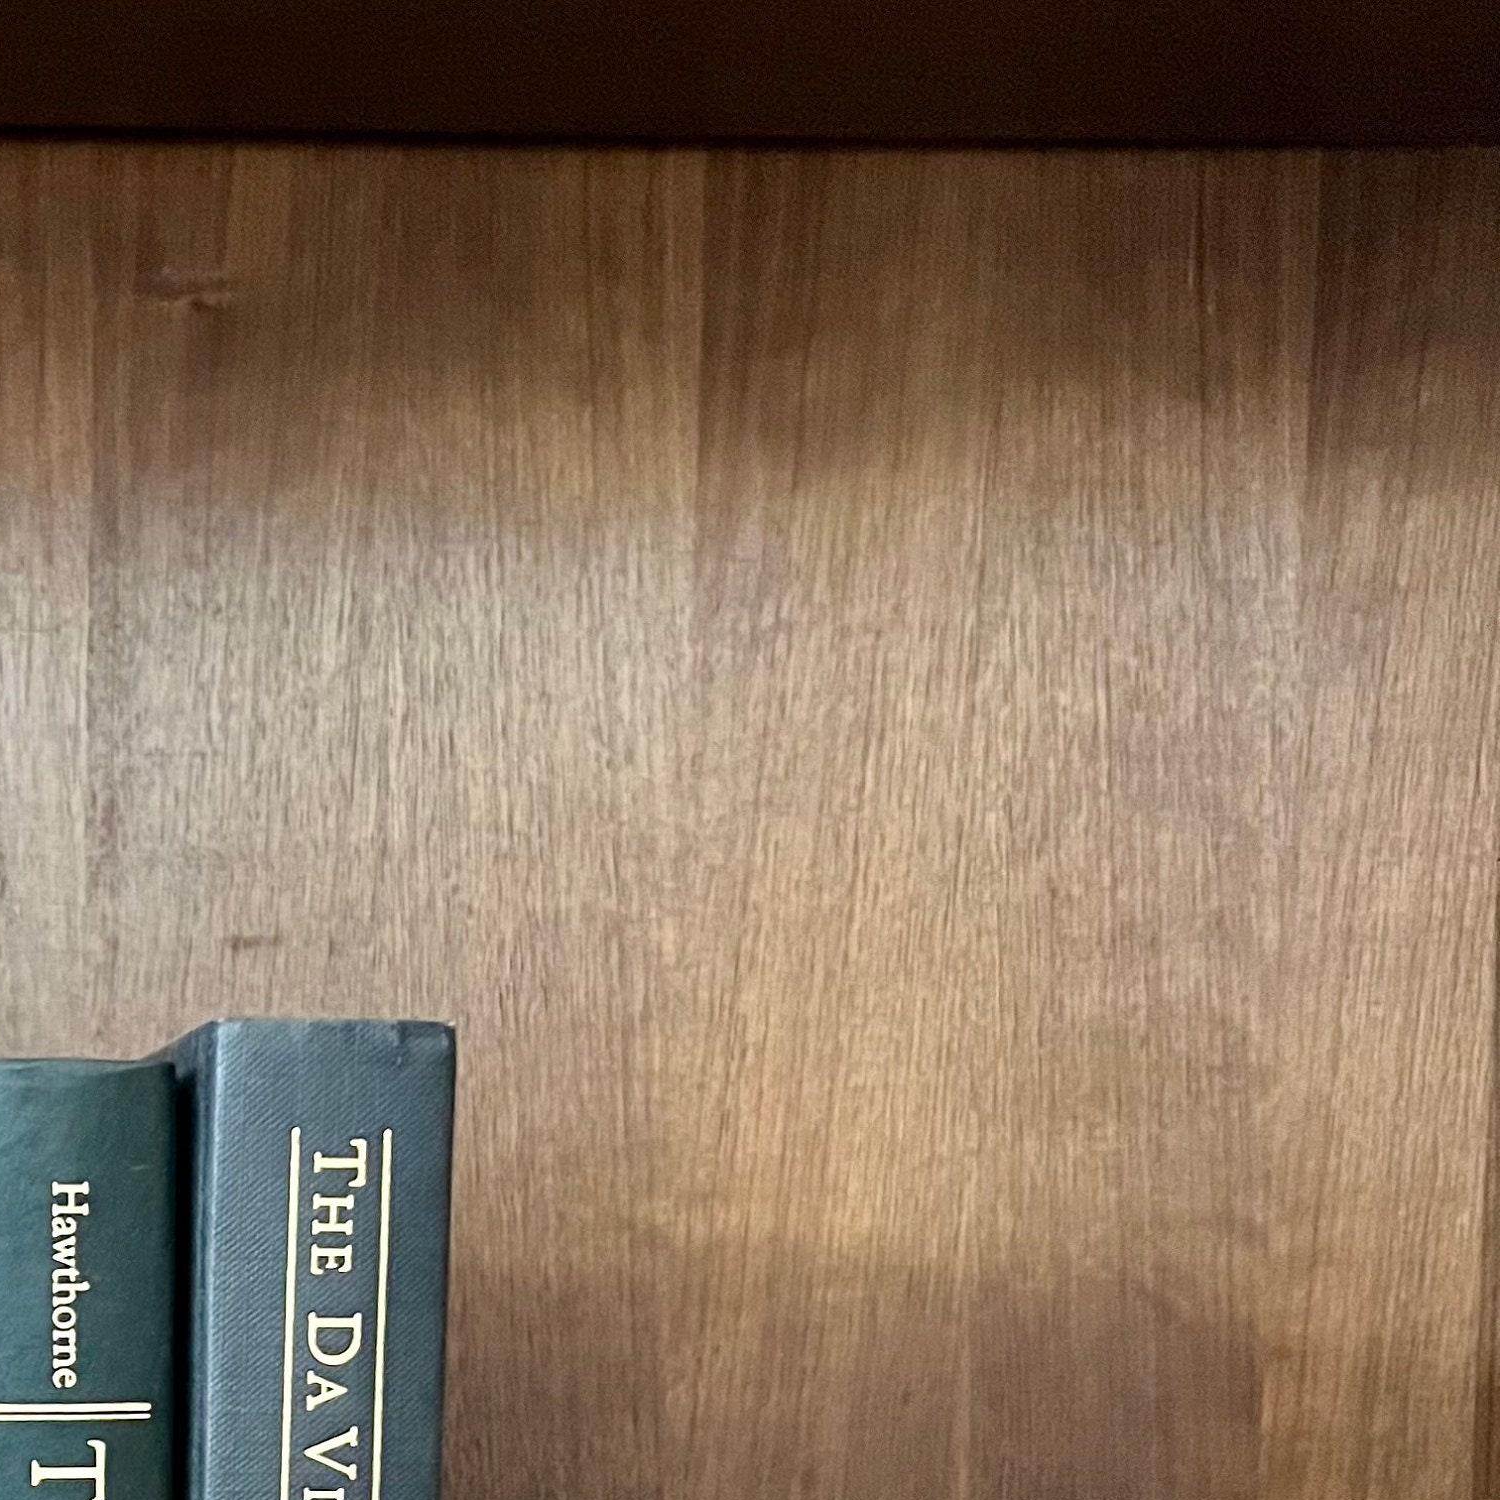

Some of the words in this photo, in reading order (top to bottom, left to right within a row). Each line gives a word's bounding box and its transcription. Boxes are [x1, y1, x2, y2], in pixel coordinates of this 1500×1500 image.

[309, 1138, 368, 1276] THE
[51, 1181, 91, 1389] Hawthorne
[305, 1311, 363, 1412] DA
